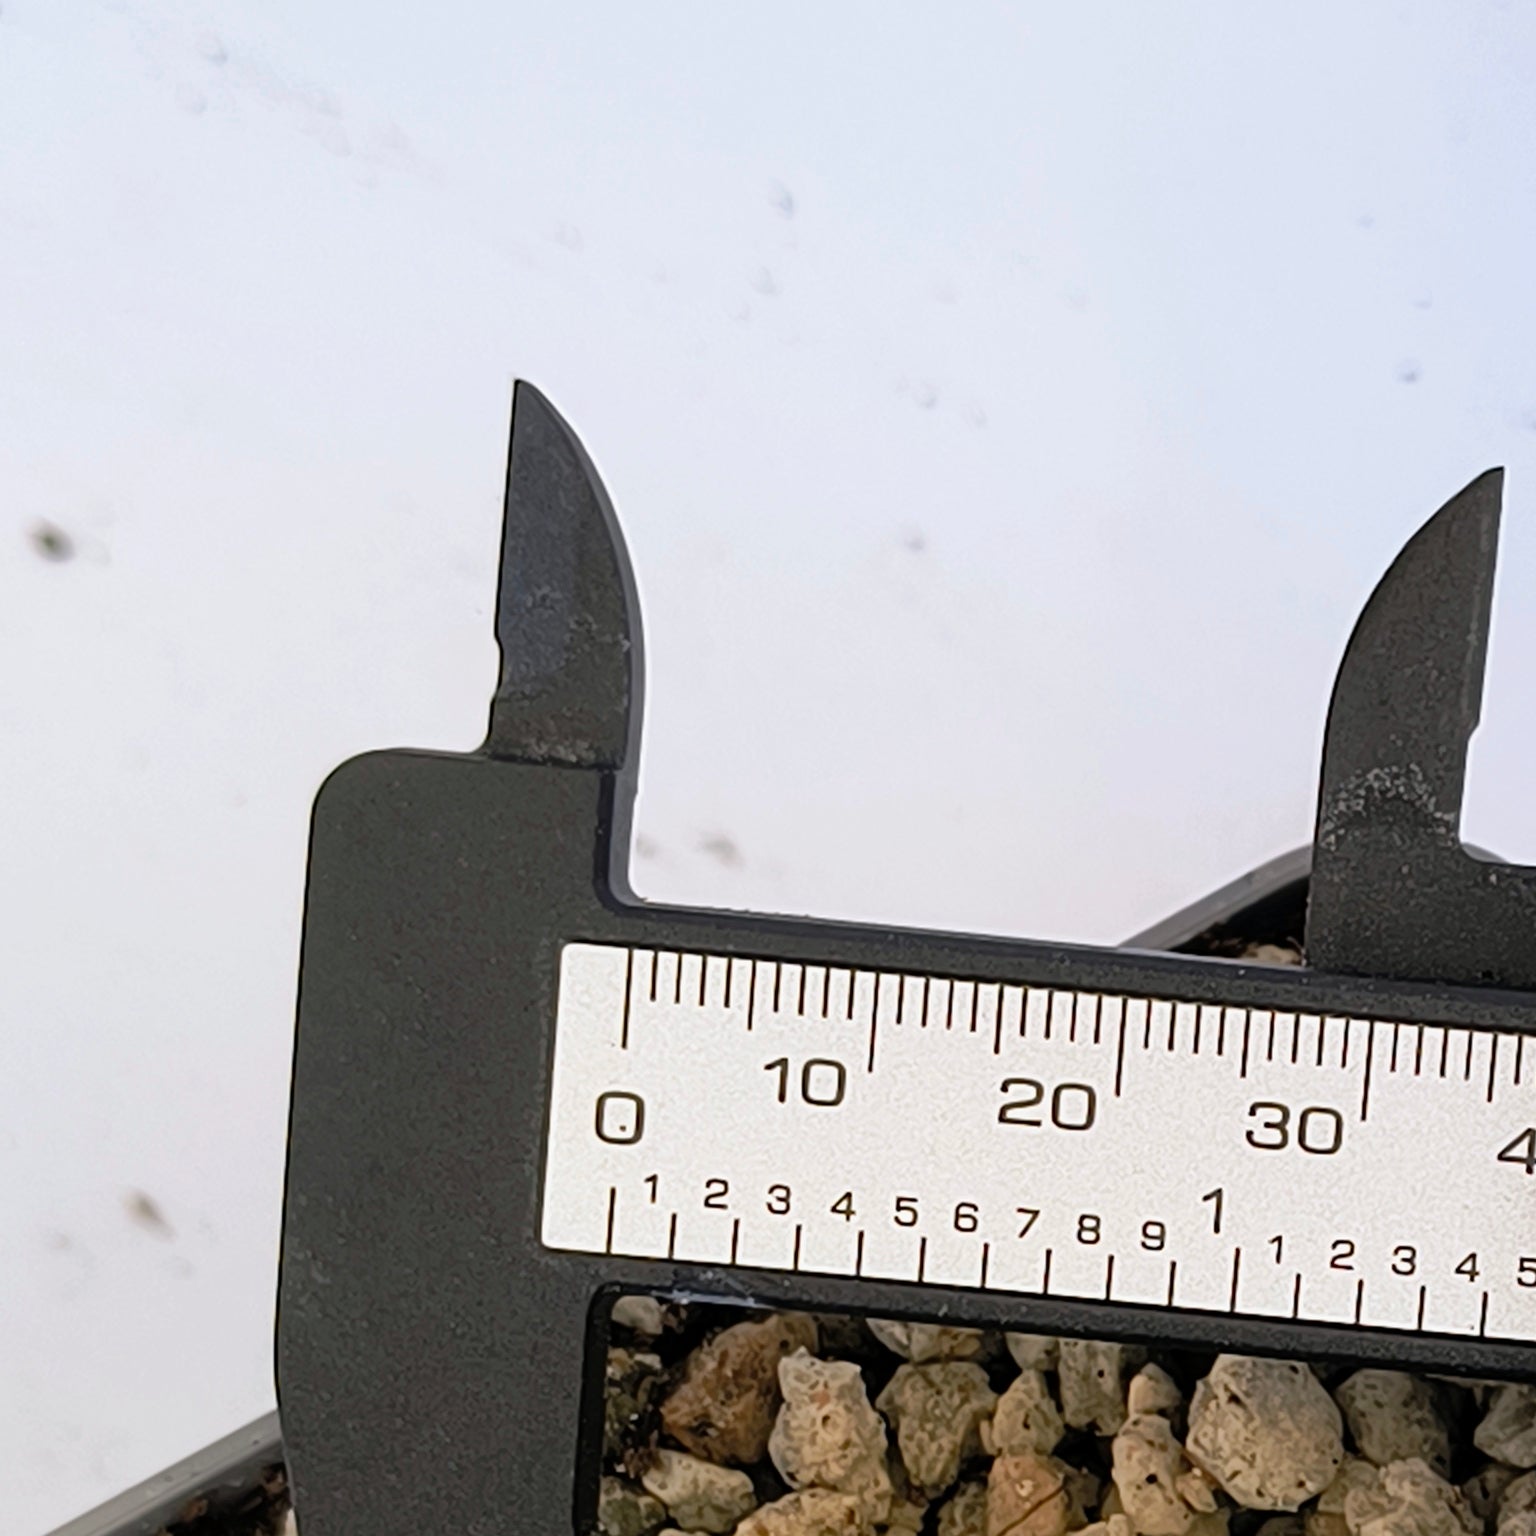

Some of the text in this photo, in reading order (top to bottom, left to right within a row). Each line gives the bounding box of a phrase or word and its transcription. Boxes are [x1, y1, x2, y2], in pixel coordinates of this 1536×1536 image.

[595, 1092, 644, 1145] 0
[764, 1058, 846, 1106] 10
[998, 1078, 1096, 1130] 20
[1246, 1102, 1343, 1154] 30
[645, 1174, 657, 1203] 1
[704, 1179, 728, 1209] 2
[767, 1185, 790, 1214] 3
[831, 1192, 855, 1221] 4
[894, 1197, 918, 1226] 5
[954, 1202, 978, 1232] 6
[1017, 1208, 1040, 1238] 7
[1077, 1214, 1100, 1244] 8
[1141, 1221, 1165, 1250] 9
[1203, 1188, 1222, 1234] 1
[1270, 1236, 1282, 1264] 1
[1330, 1240, 1354, 1270] 2
[1392, 1246, 1416, 1275] 3
[1455, 1253, 1479, 1282] 4
